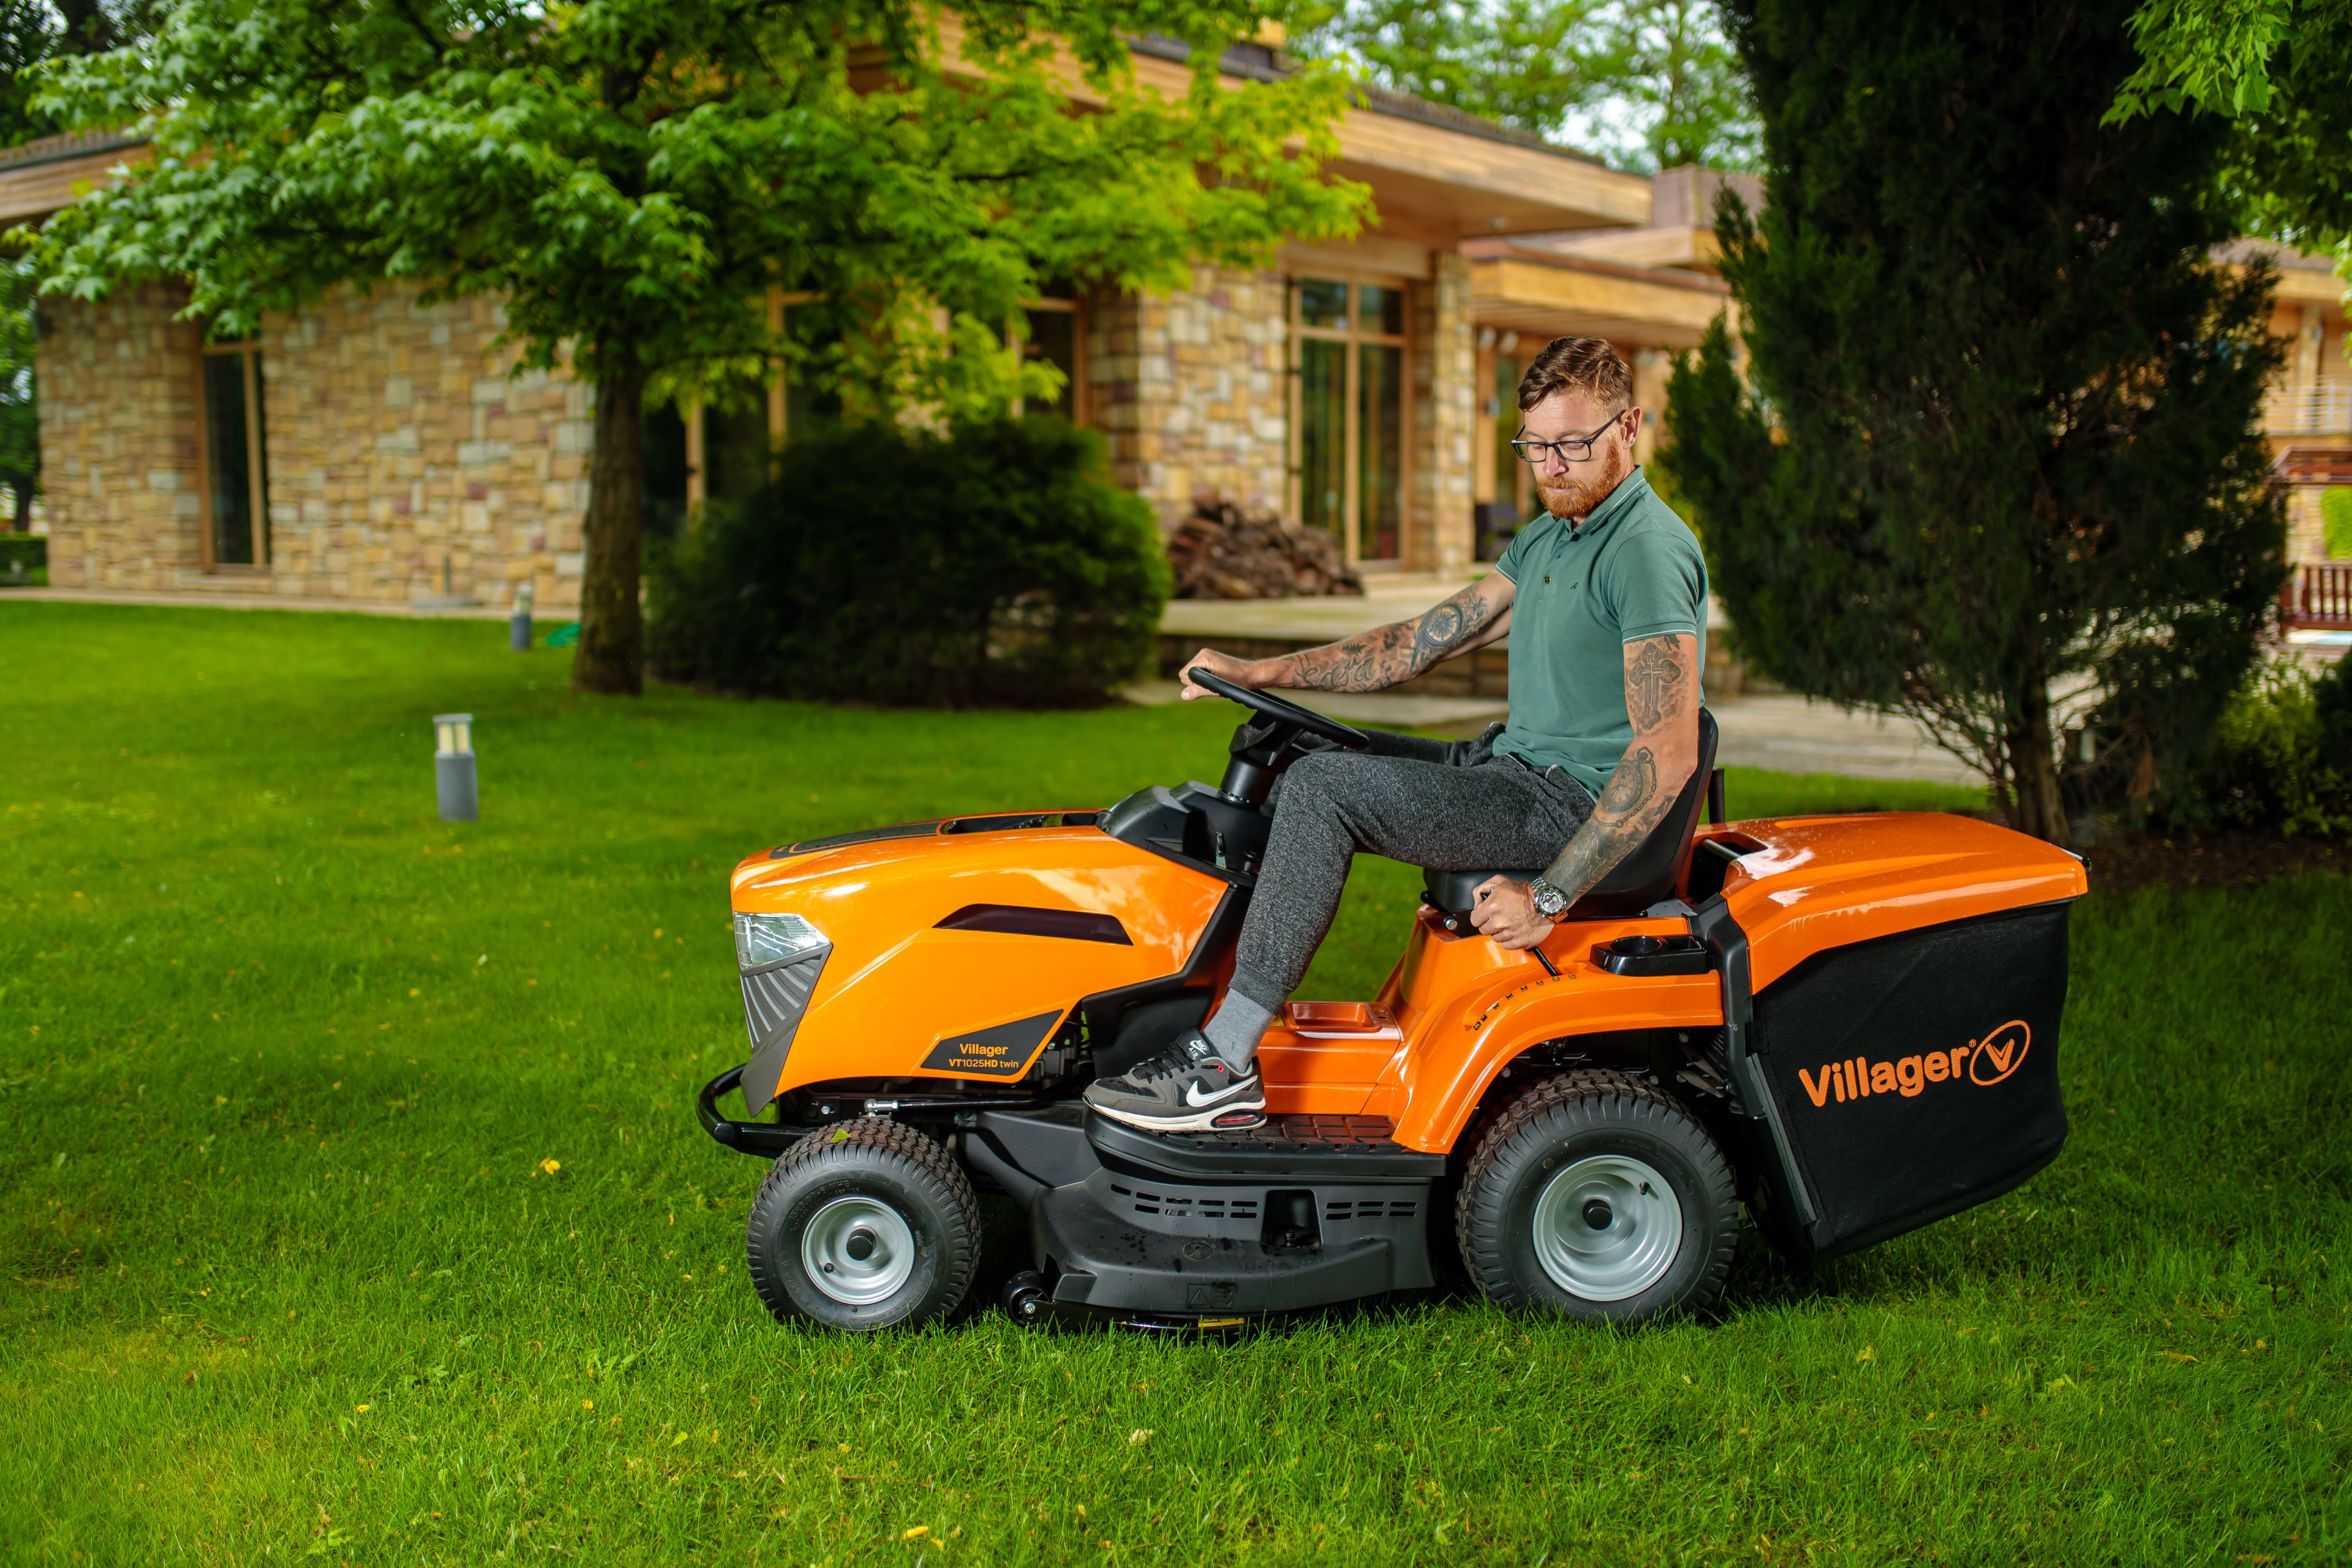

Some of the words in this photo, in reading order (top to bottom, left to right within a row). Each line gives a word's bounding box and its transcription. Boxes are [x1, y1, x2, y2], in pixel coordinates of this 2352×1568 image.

[959, 1043, 1008, 1055] Villager
[1195, 1039, 1208, 1052] NIKE
[1188, 1047, 1199, 1058] AIR
[949, 1058, 998, 1068] VT1025HD
[1000, 1060, 1019, 1068] twin
[1798, 1046, 1970, 1107] Villager
